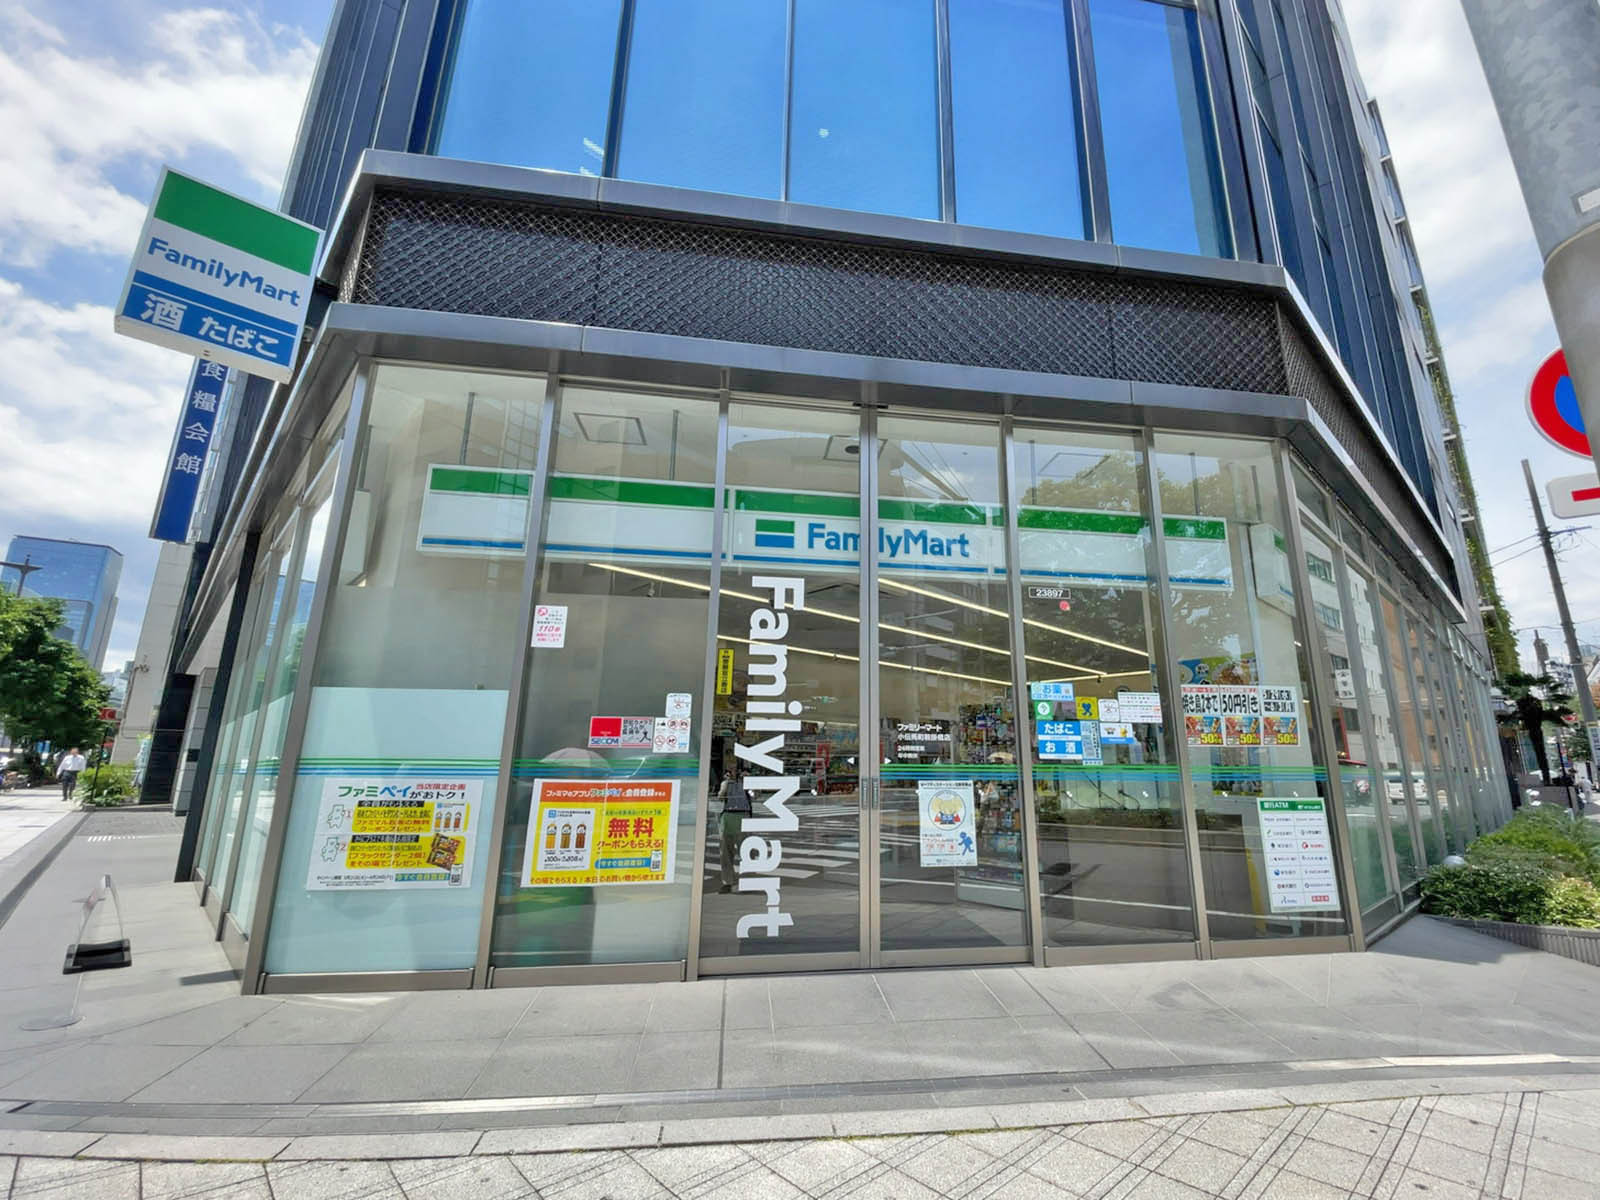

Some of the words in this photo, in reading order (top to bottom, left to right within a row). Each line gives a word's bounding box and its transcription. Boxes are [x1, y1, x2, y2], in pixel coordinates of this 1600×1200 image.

[147, 237, 301, 307] FamilyMart
[140, 293, 188, 332] 酒
[198, 315, 280, 359] たばこ
[175, 360, 225, 475] 食糧会館
[808, 522, 970, 558] FamlyMart
[897, 723, 943, 732] ファミリーマート
[1044, 722, 1075, 734] たばこ
[734, 575, 805, 938] FamilyMart
[608, 817, 655, 838] 無料
